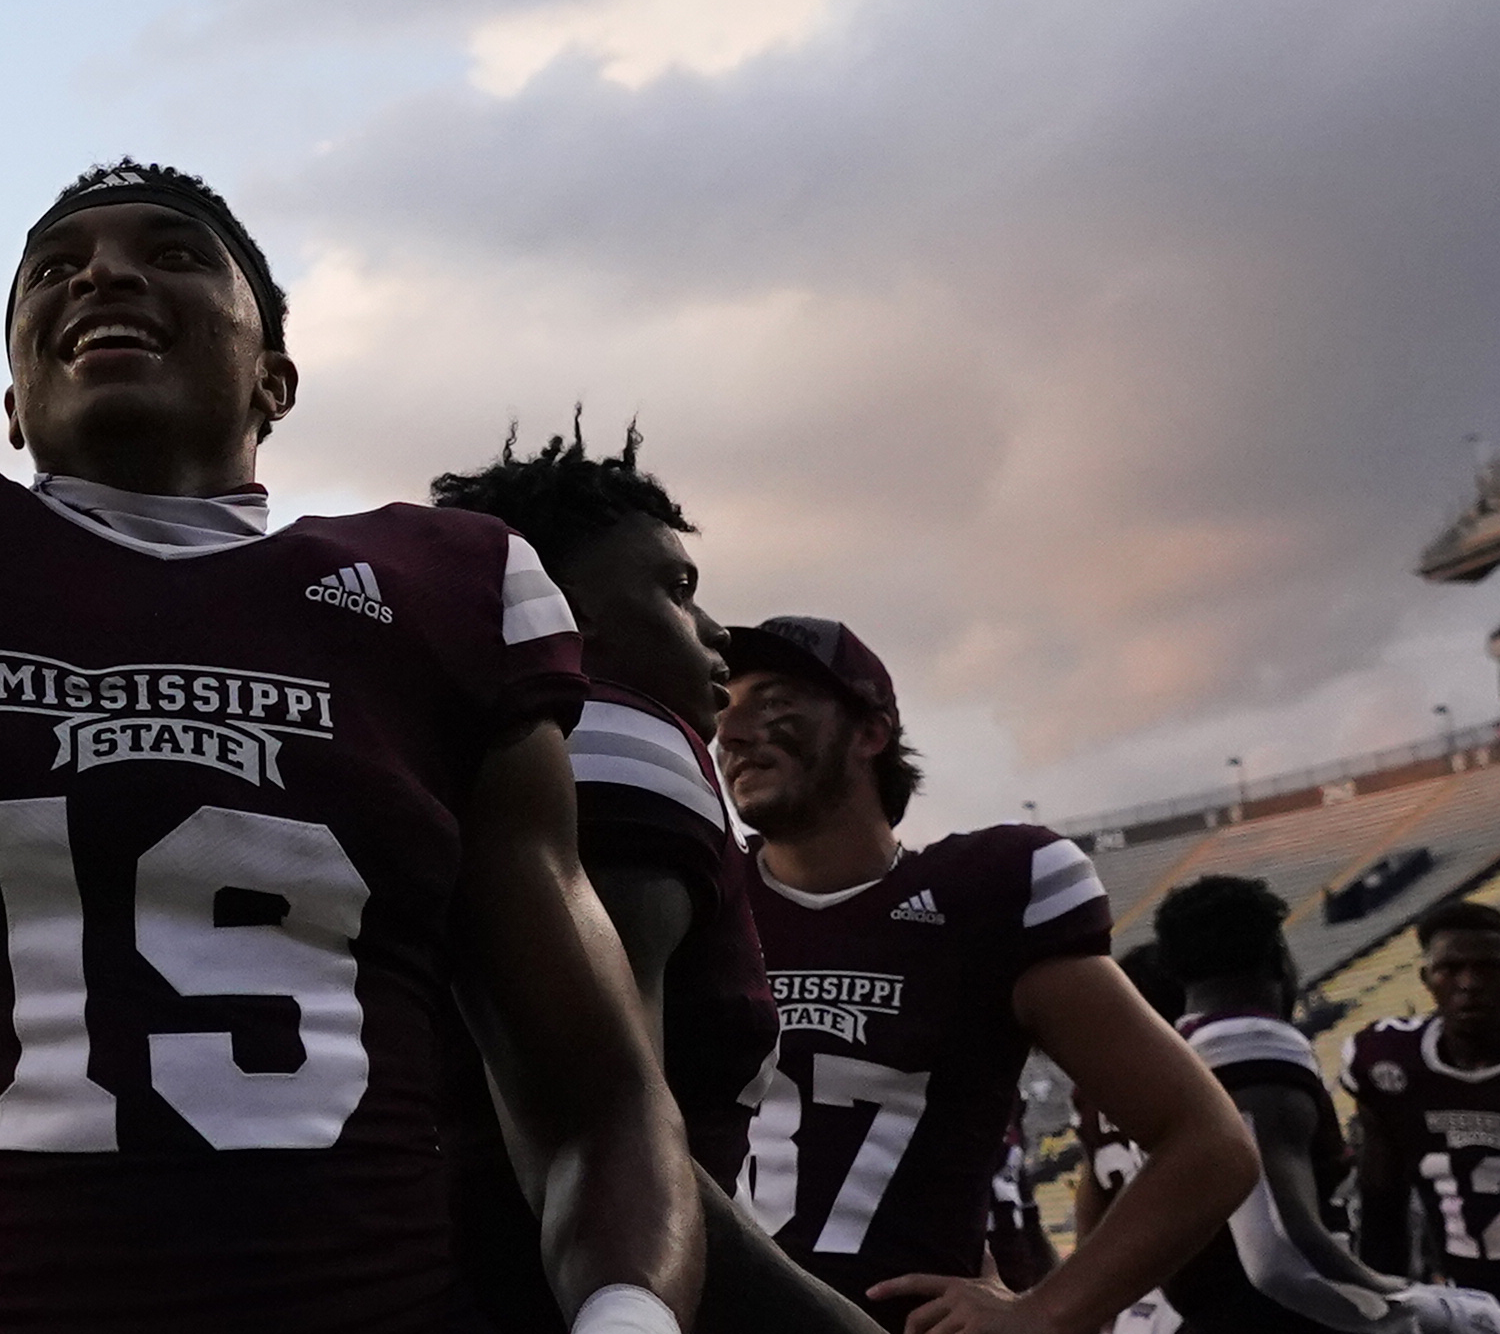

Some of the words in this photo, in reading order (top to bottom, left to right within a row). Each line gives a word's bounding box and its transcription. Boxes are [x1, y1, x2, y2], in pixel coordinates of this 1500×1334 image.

[305, 585, 393, 624] adidas
[92, 719, 245, 768] STATE
[890, 907, 946, 925] adidas
